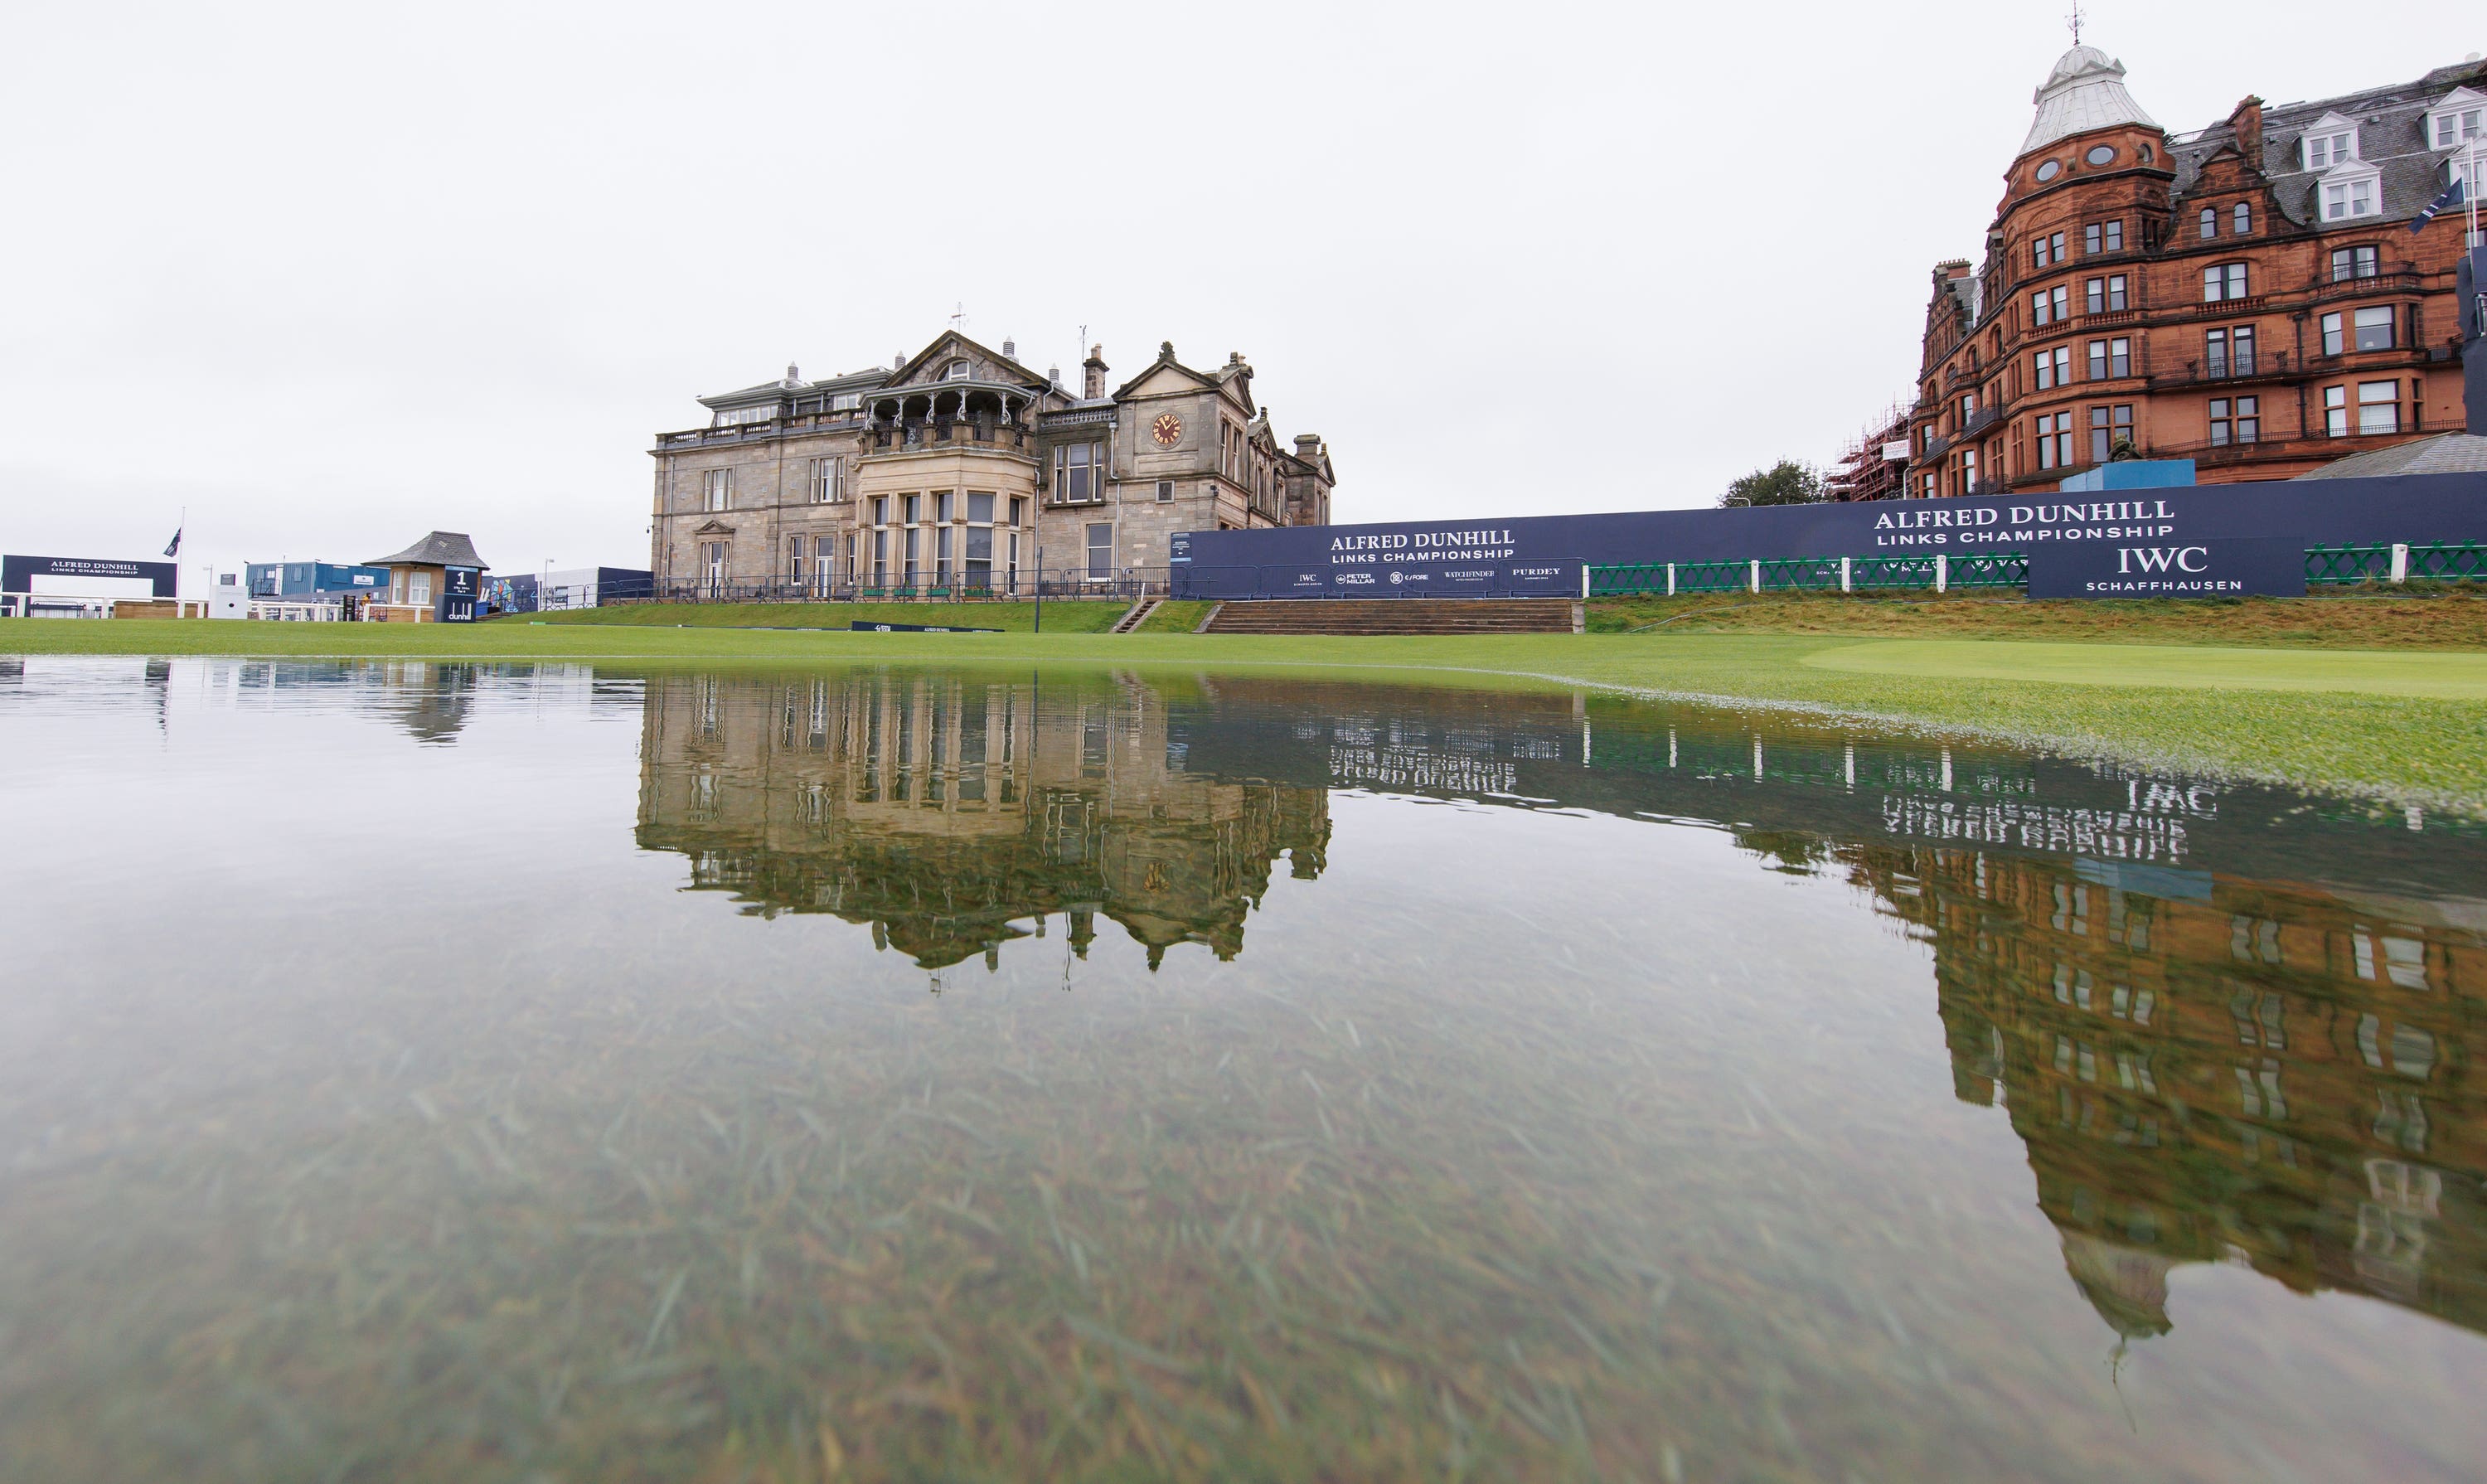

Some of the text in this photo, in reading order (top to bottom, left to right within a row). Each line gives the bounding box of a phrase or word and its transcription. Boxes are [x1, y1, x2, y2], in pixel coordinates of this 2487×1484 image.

[1874, 501, 2175, 529] ALFRED DUNHILL
[1331, 530, 1515, 551] ALFRED DUNHILL
[1877, 524, 2174, 546] LINKS CHAMPIONSHIP
[1332, 548, 1514, 564] LINKS CHAMPIONSHIP
[2117, 547, 2208, 574] IWC
[457, 571, 466, 585] 1
[1299, 574, 1316, 582] IWC
[1513, 568, 1560, 576] PURDEY
[2087, 580, 2242, 591] SCHAFFHAUSEN
